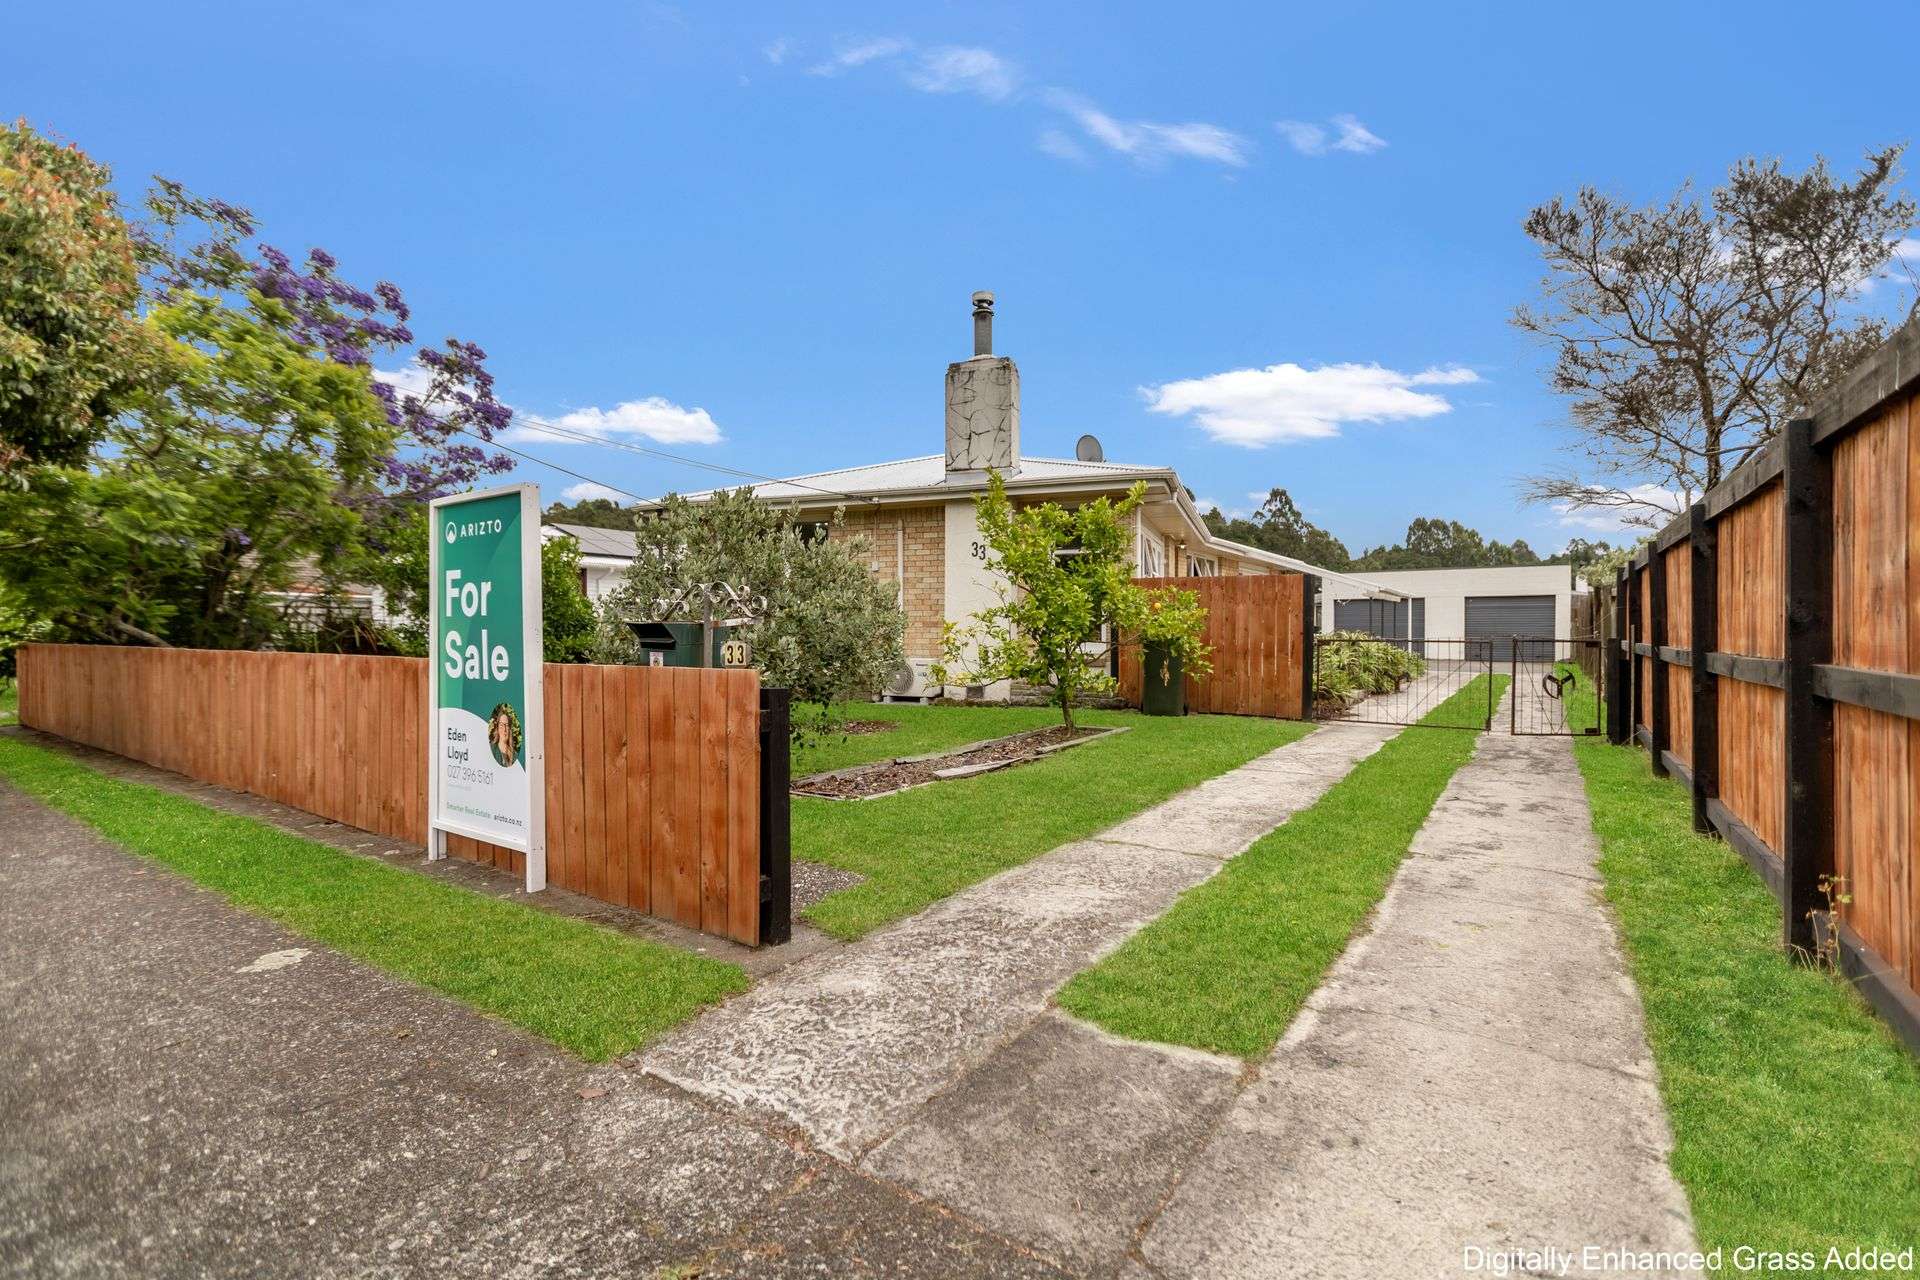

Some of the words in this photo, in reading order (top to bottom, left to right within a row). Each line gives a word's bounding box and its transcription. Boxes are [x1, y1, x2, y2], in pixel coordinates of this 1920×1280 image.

[460, 519, 502, 538] ARIZTO
[971, 541, 986, 560] 33
[445, 569, 492, 618] For
[445, 629, 510, 681] Sale
[726, 644, 745, 664] 33
[447, 727, 467, 742] Eden
[447, 745, 469, 765] Lloyd
[447, 764, 461, 779] 027
